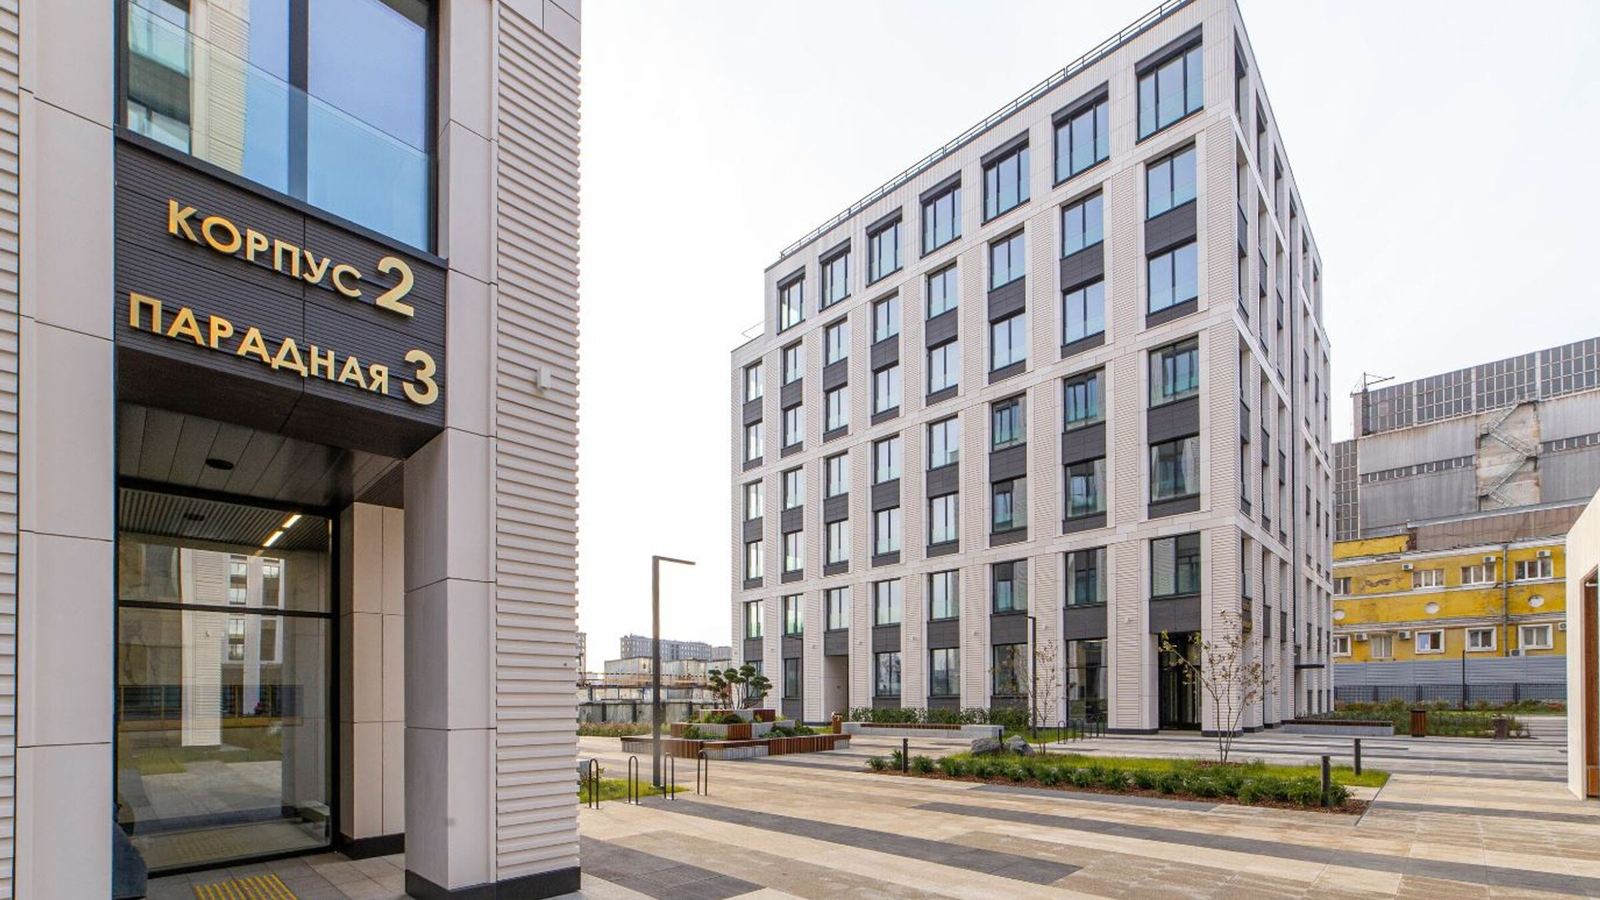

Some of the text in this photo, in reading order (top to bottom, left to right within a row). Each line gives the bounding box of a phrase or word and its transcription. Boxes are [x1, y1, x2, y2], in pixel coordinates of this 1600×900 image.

[168, 199, 414, 317] КОРПУС 2
[129, 292, 438, 406] ПАРАДНАЯ 3
